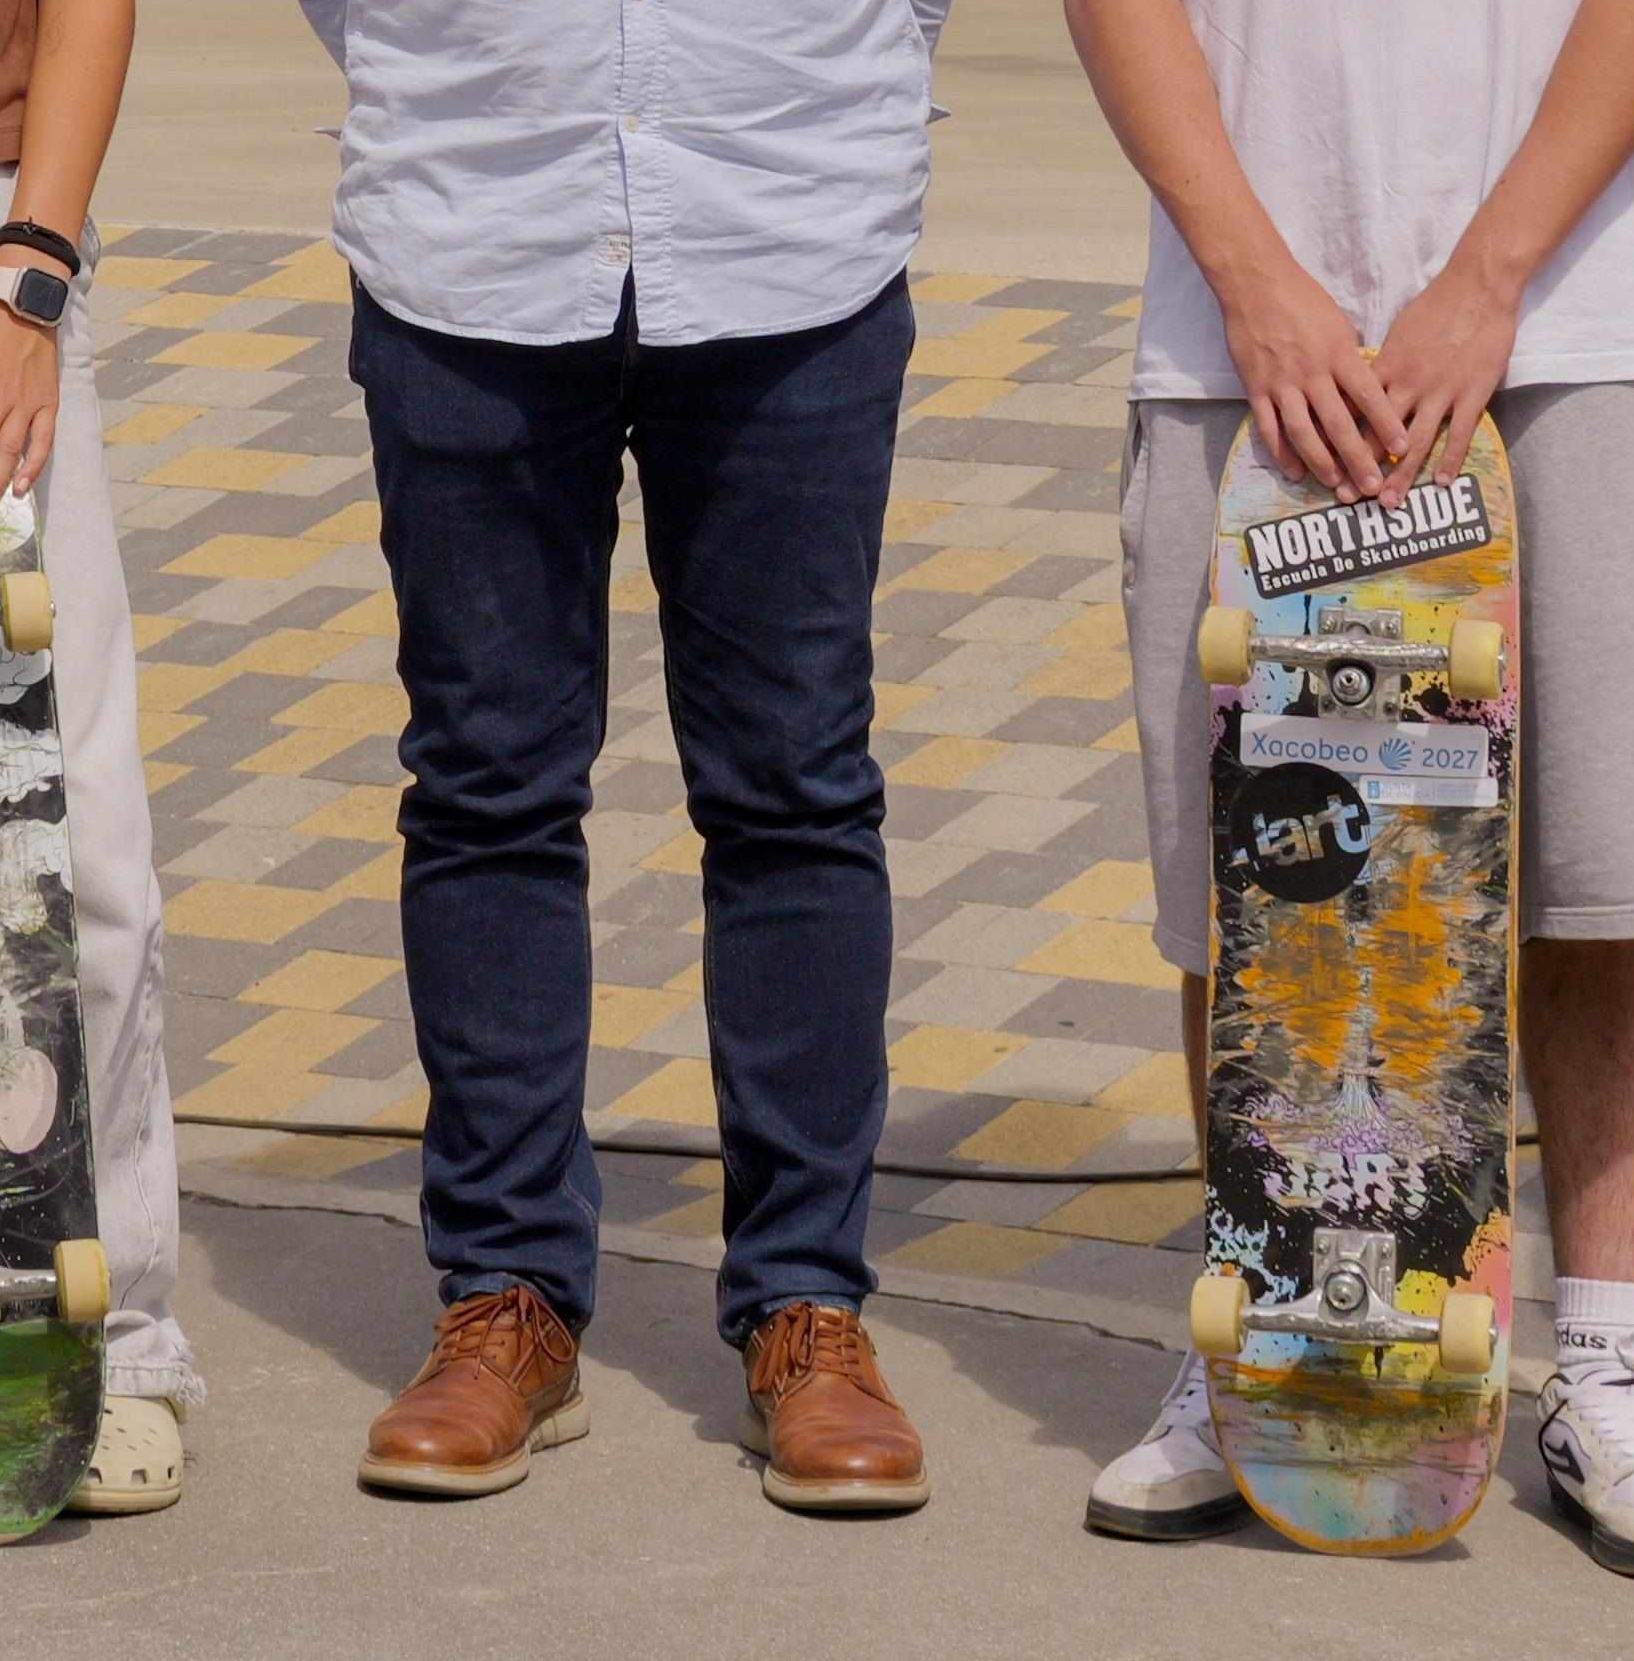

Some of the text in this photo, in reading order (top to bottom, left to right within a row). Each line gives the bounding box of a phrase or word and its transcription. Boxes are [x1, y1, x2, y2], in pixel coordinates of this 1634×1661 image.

[1248, 475, 1481, 575] NORTHSIDE
[1260, 523, 1488, 592] Escuela De Skateboarding
[1251, 731, 1479, 770] Xacobeo 2027
